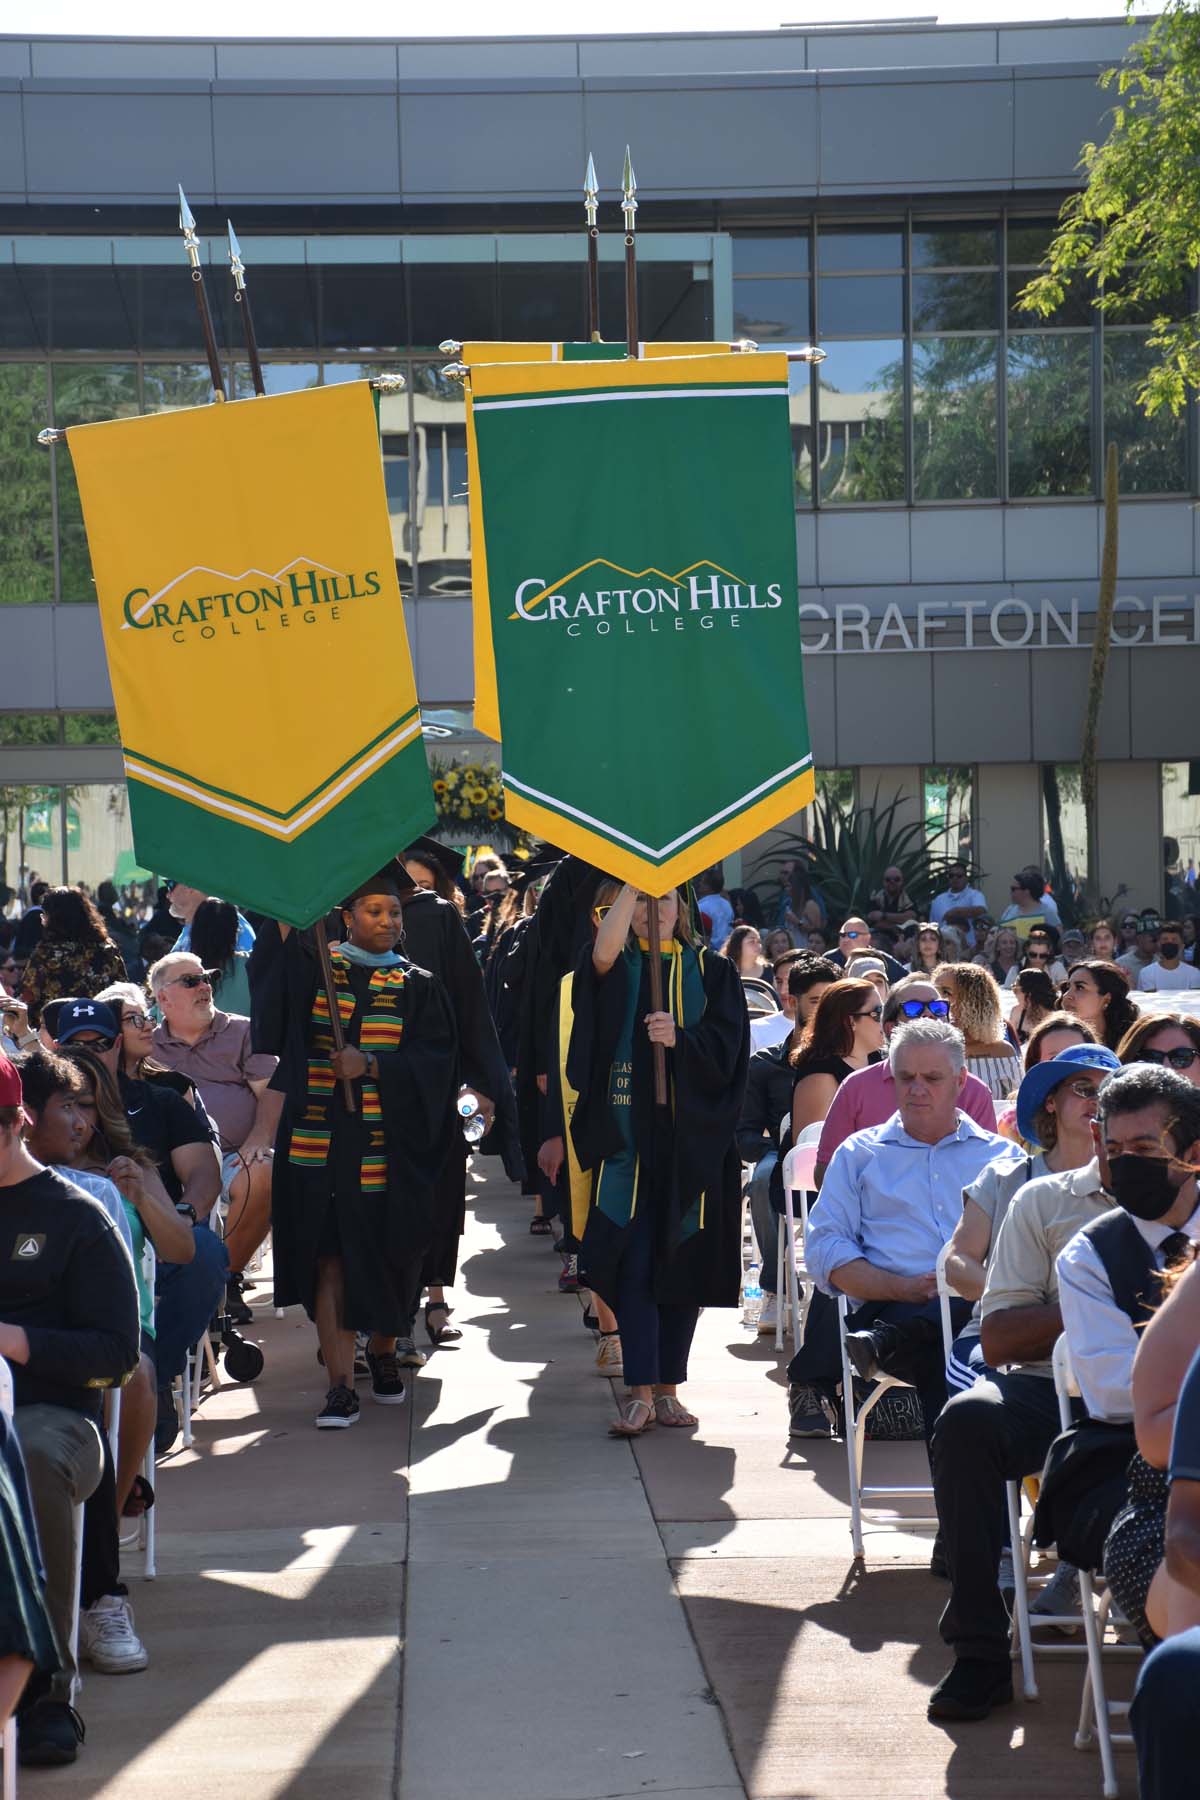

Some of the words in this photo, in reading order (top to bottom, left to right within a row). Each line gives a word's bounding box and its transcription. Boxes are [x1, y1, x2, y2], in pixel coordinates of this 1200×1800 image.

[123, 585, 285, 629] CRAFTON
[287, 570, 381, 607] HILLS
[514, 578, 681, 621] CRAFTON
[687, 574, 783, 611] HILLS
[172, 606, 341, 643] COLLEGE
[566, 614, 741, 637] COLLEGE
[798, 598, 1079, 652] CRAFTON
[1109, 594, 1200, 645] CE
[617, 1077, 631, 1089] OF
